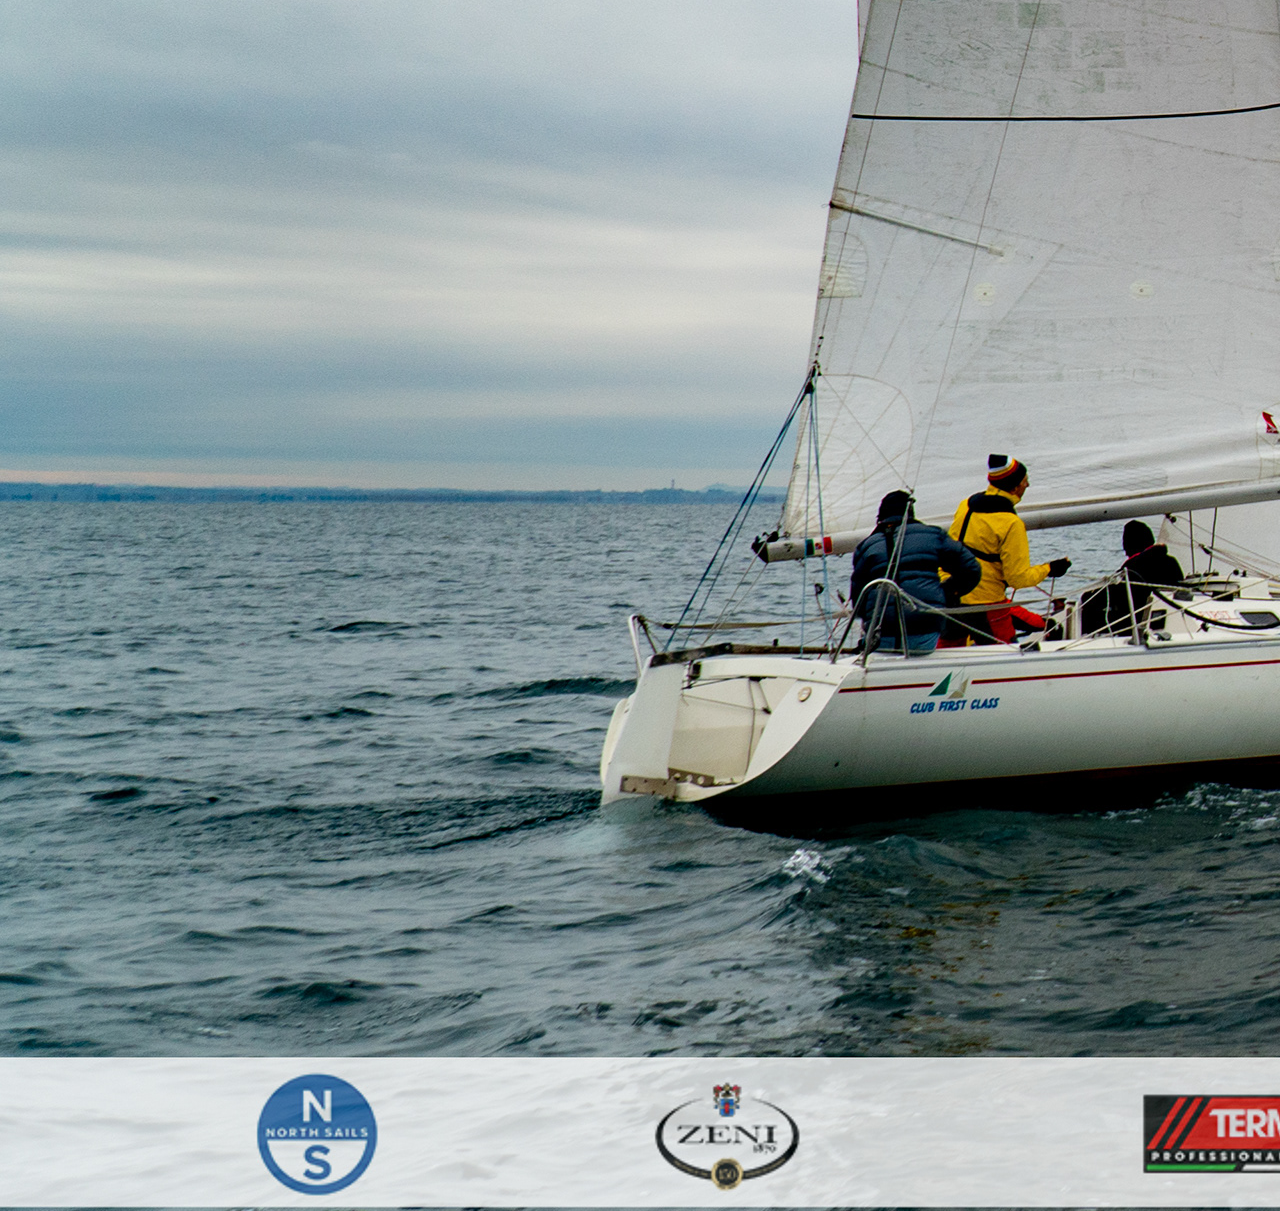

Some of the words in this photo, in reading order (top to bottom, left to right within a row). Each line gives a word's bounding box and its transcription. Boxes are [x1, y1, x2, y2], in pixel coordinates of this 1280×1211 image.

[910, 702, 936, 714] CLUB
[938, 699, 967, 712] FIRST
[970, 697, 1000, 710] CLASS
